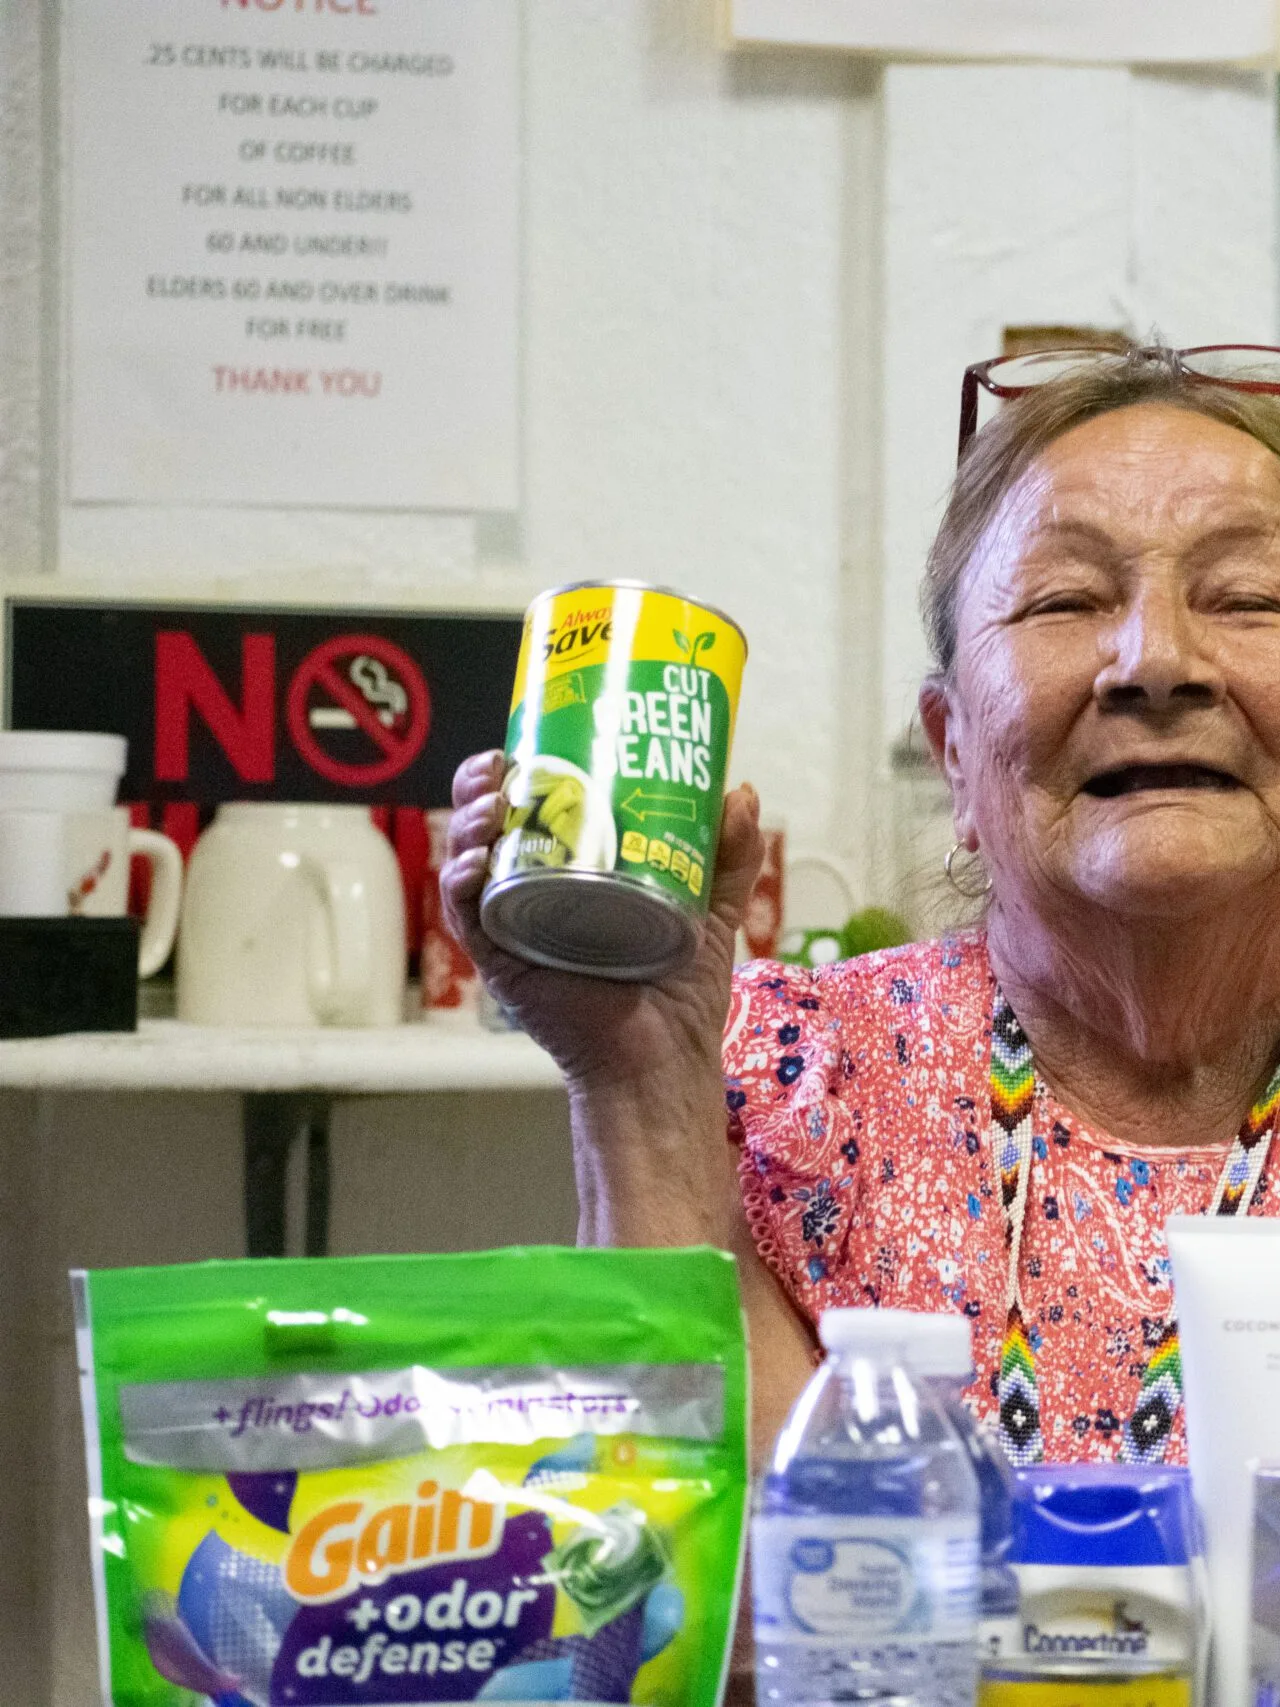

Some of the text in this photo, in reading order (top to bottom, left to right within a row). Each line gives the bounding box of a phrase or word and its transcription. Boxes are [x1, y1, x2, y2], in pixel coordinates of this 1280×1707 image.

[181, 45, 251, 69] CENTS
[256, 48, 308, 72] WILL
[316, 49, 341, 72] BE
[347, 51, 455, 76] CHARGED
[218, 92, 379, 119] FOR EACH CUP
[238, 139, 356, 165] OF COFFEE
[181, 184, 413, 213] FOR ALL NON ELDERS
[205, 231, 235, 253] 60
[239, 232, 288, 255] AND
[145, 274, 451, 304] ELDERS 60 AND OVER DRINK
[244, 317, 348, 341] FOR FREE
[212, 365, 383, 398] THANK YOU
[663, 663, 711, 700] CUT
[593, 690, 712, 746] REEN
[592, 734, 711, 791] EANS
[285, 1478, 495, 1599] Gain
[346, 1578, 539, 1633] +odor
[296, 1632, 498, 1684] defense
